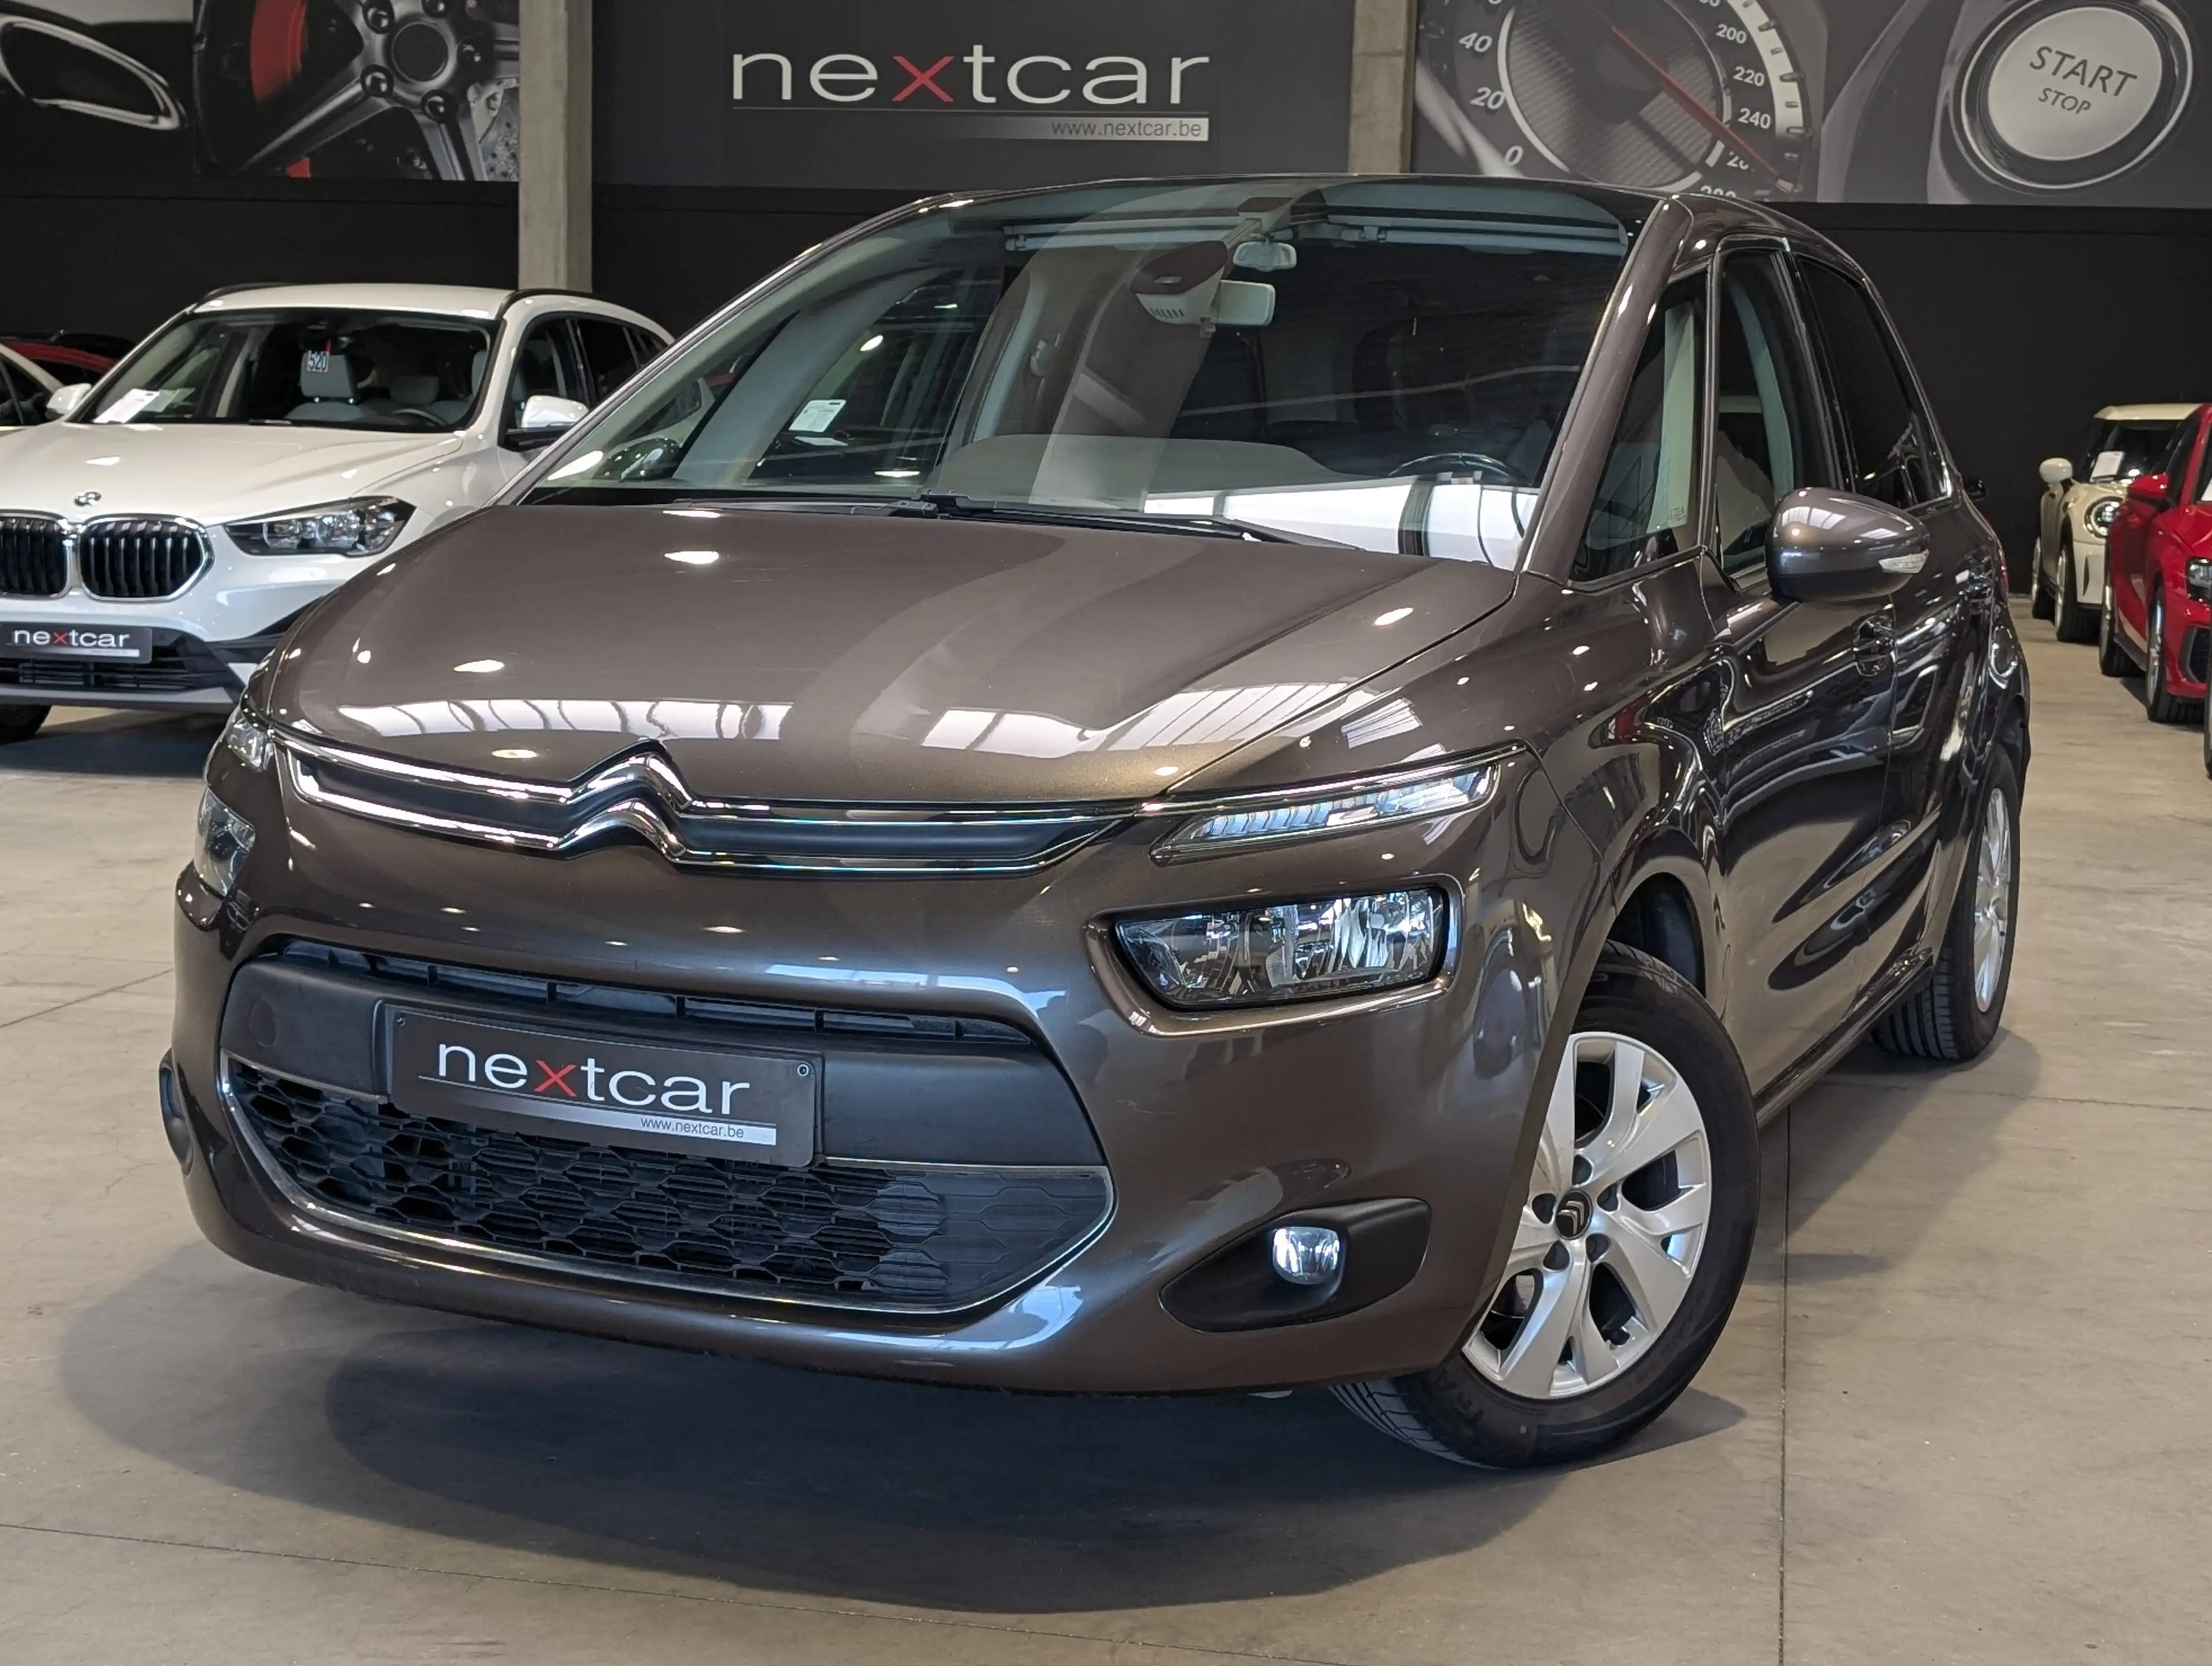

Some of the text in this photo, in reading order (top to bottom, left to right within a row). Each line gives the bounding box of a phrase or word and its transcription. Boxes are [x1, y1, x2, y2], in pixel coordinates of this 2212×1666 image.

[1458, 32, 1493, 53] 40
[1715, 23, 1748, 44] 200
[732, 44, 1210, 105] nextcar
[1733, 66, 1765, 86] 220
[2029, 45, 2138, 97] START
[1469, 87, 1504, 110] 20
[2037, 87, 2091, 115] STOP
[1051, 119, 1202, 138] www.nextcar.be
[1737, 108, 1771, 130] 240
[1505, 145, 1524, 167] 0
[14, 629, 130, 648] nextcar
[438, 1043, 751, 1115] nextcar
[640, 1116, 745, 1139] www.nextcar.be
